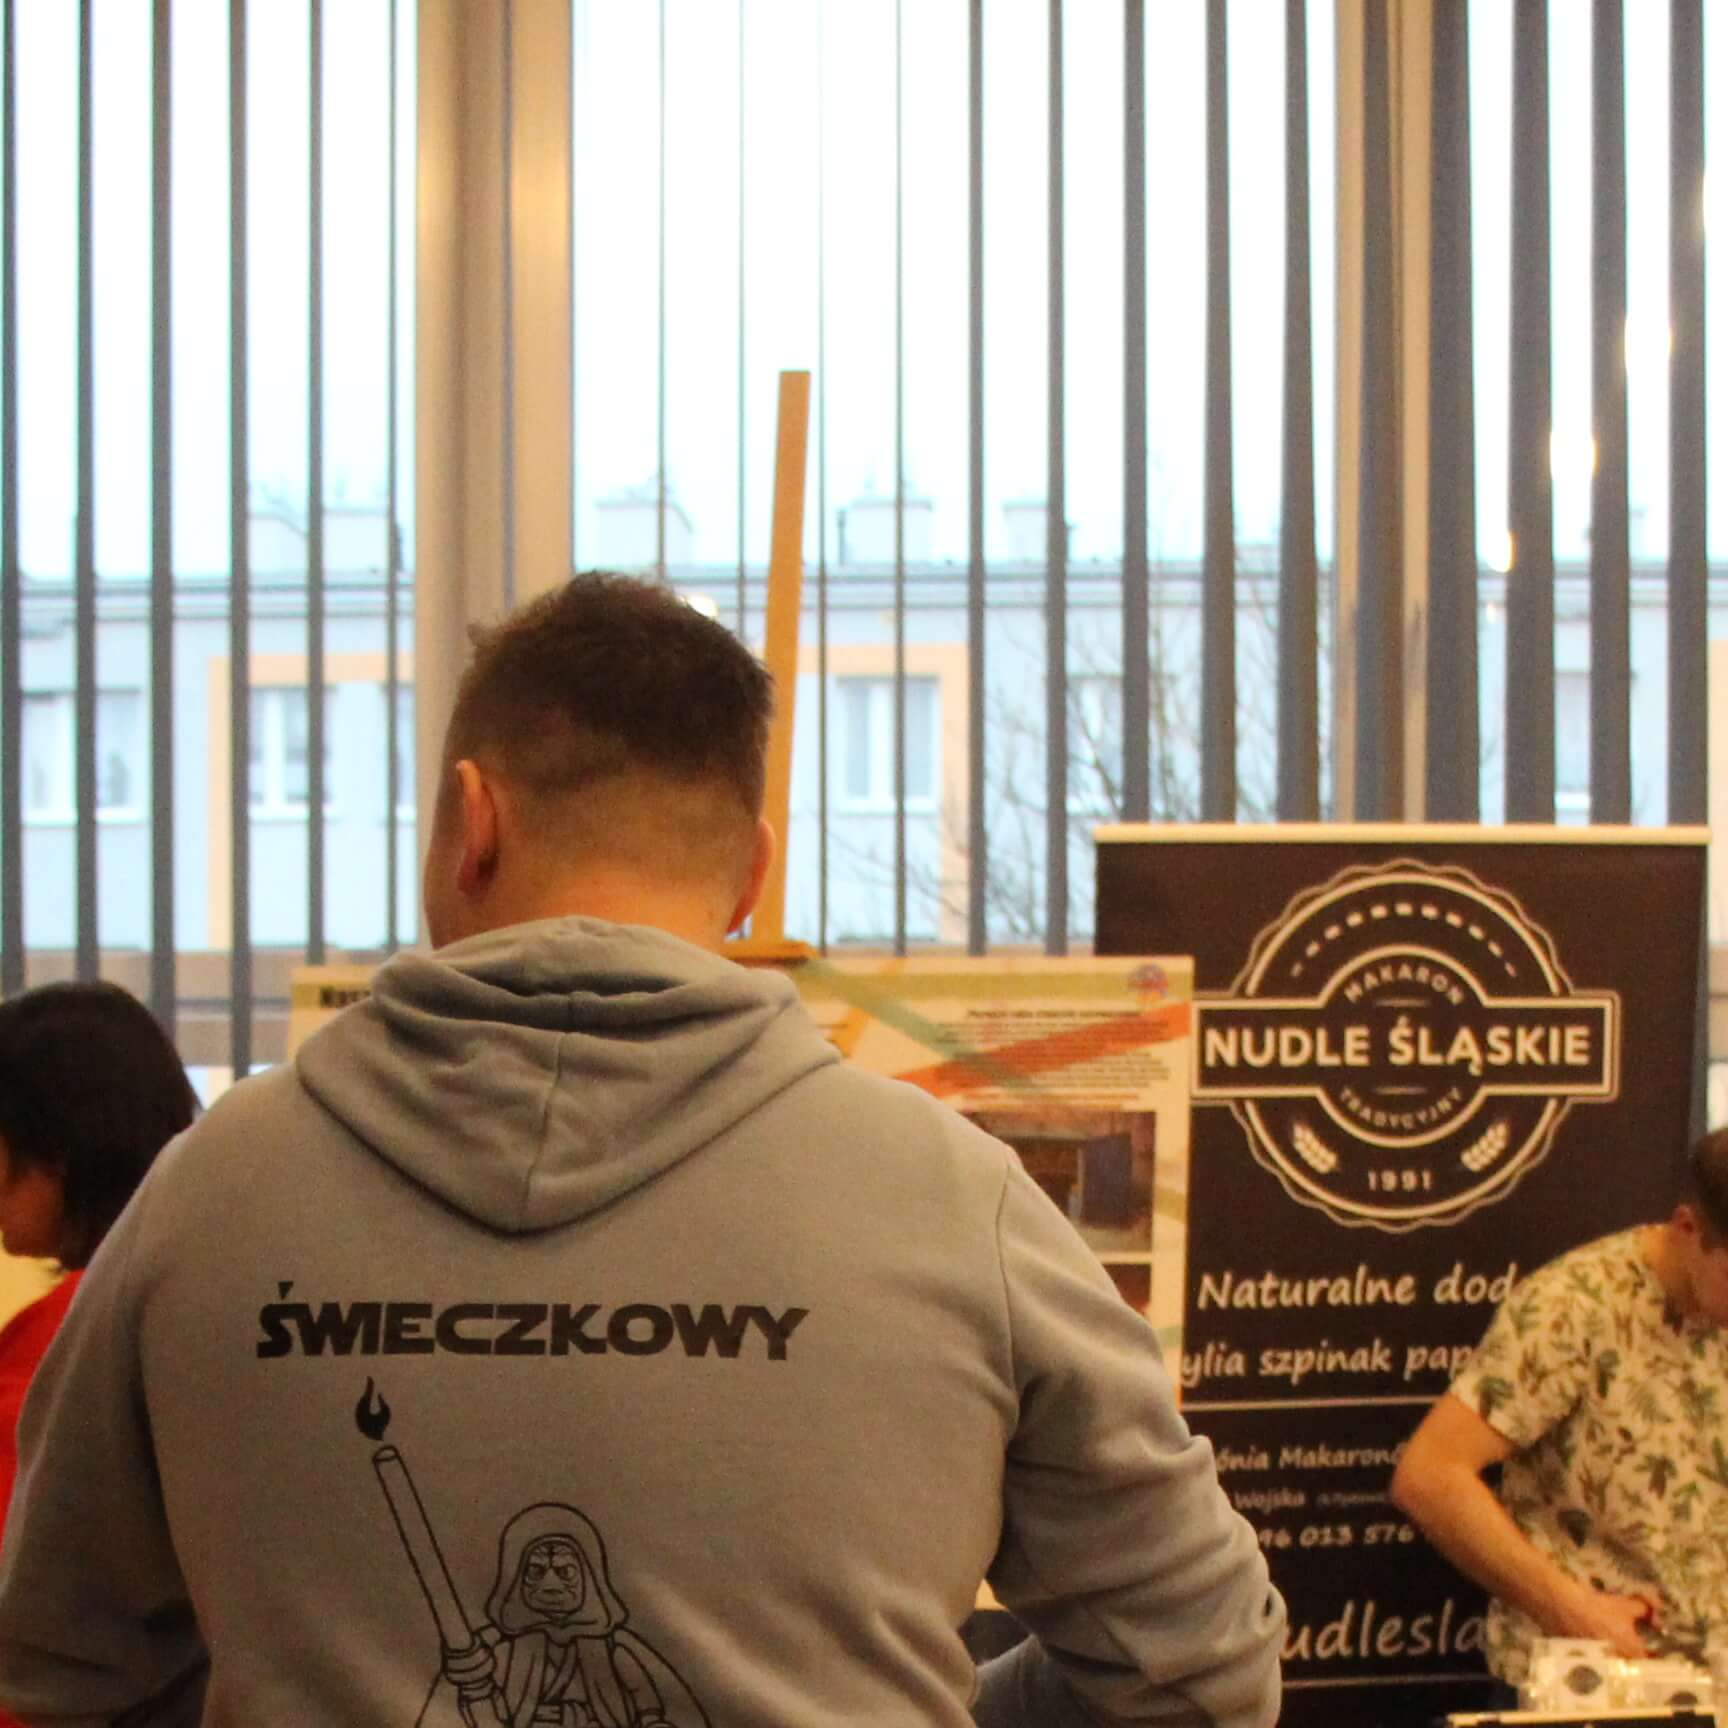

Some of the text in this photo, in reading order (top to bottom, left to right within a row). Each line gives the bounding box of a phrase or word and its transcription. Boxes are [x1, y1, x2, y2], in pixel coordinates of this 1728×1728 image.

[1204, 1026, 1370, 1068] NUDLE
[1388, 1016, 1591, 1076] ŚLĄSKIE
[1368, 1170, 1432, 1191] 1991
[1198, 1264, 1416, 1310] Naturalne
[255, 1281, 811, 1361] ŚWIECZKOWY
[1259, 1338, 1391, 1386] szpinak
